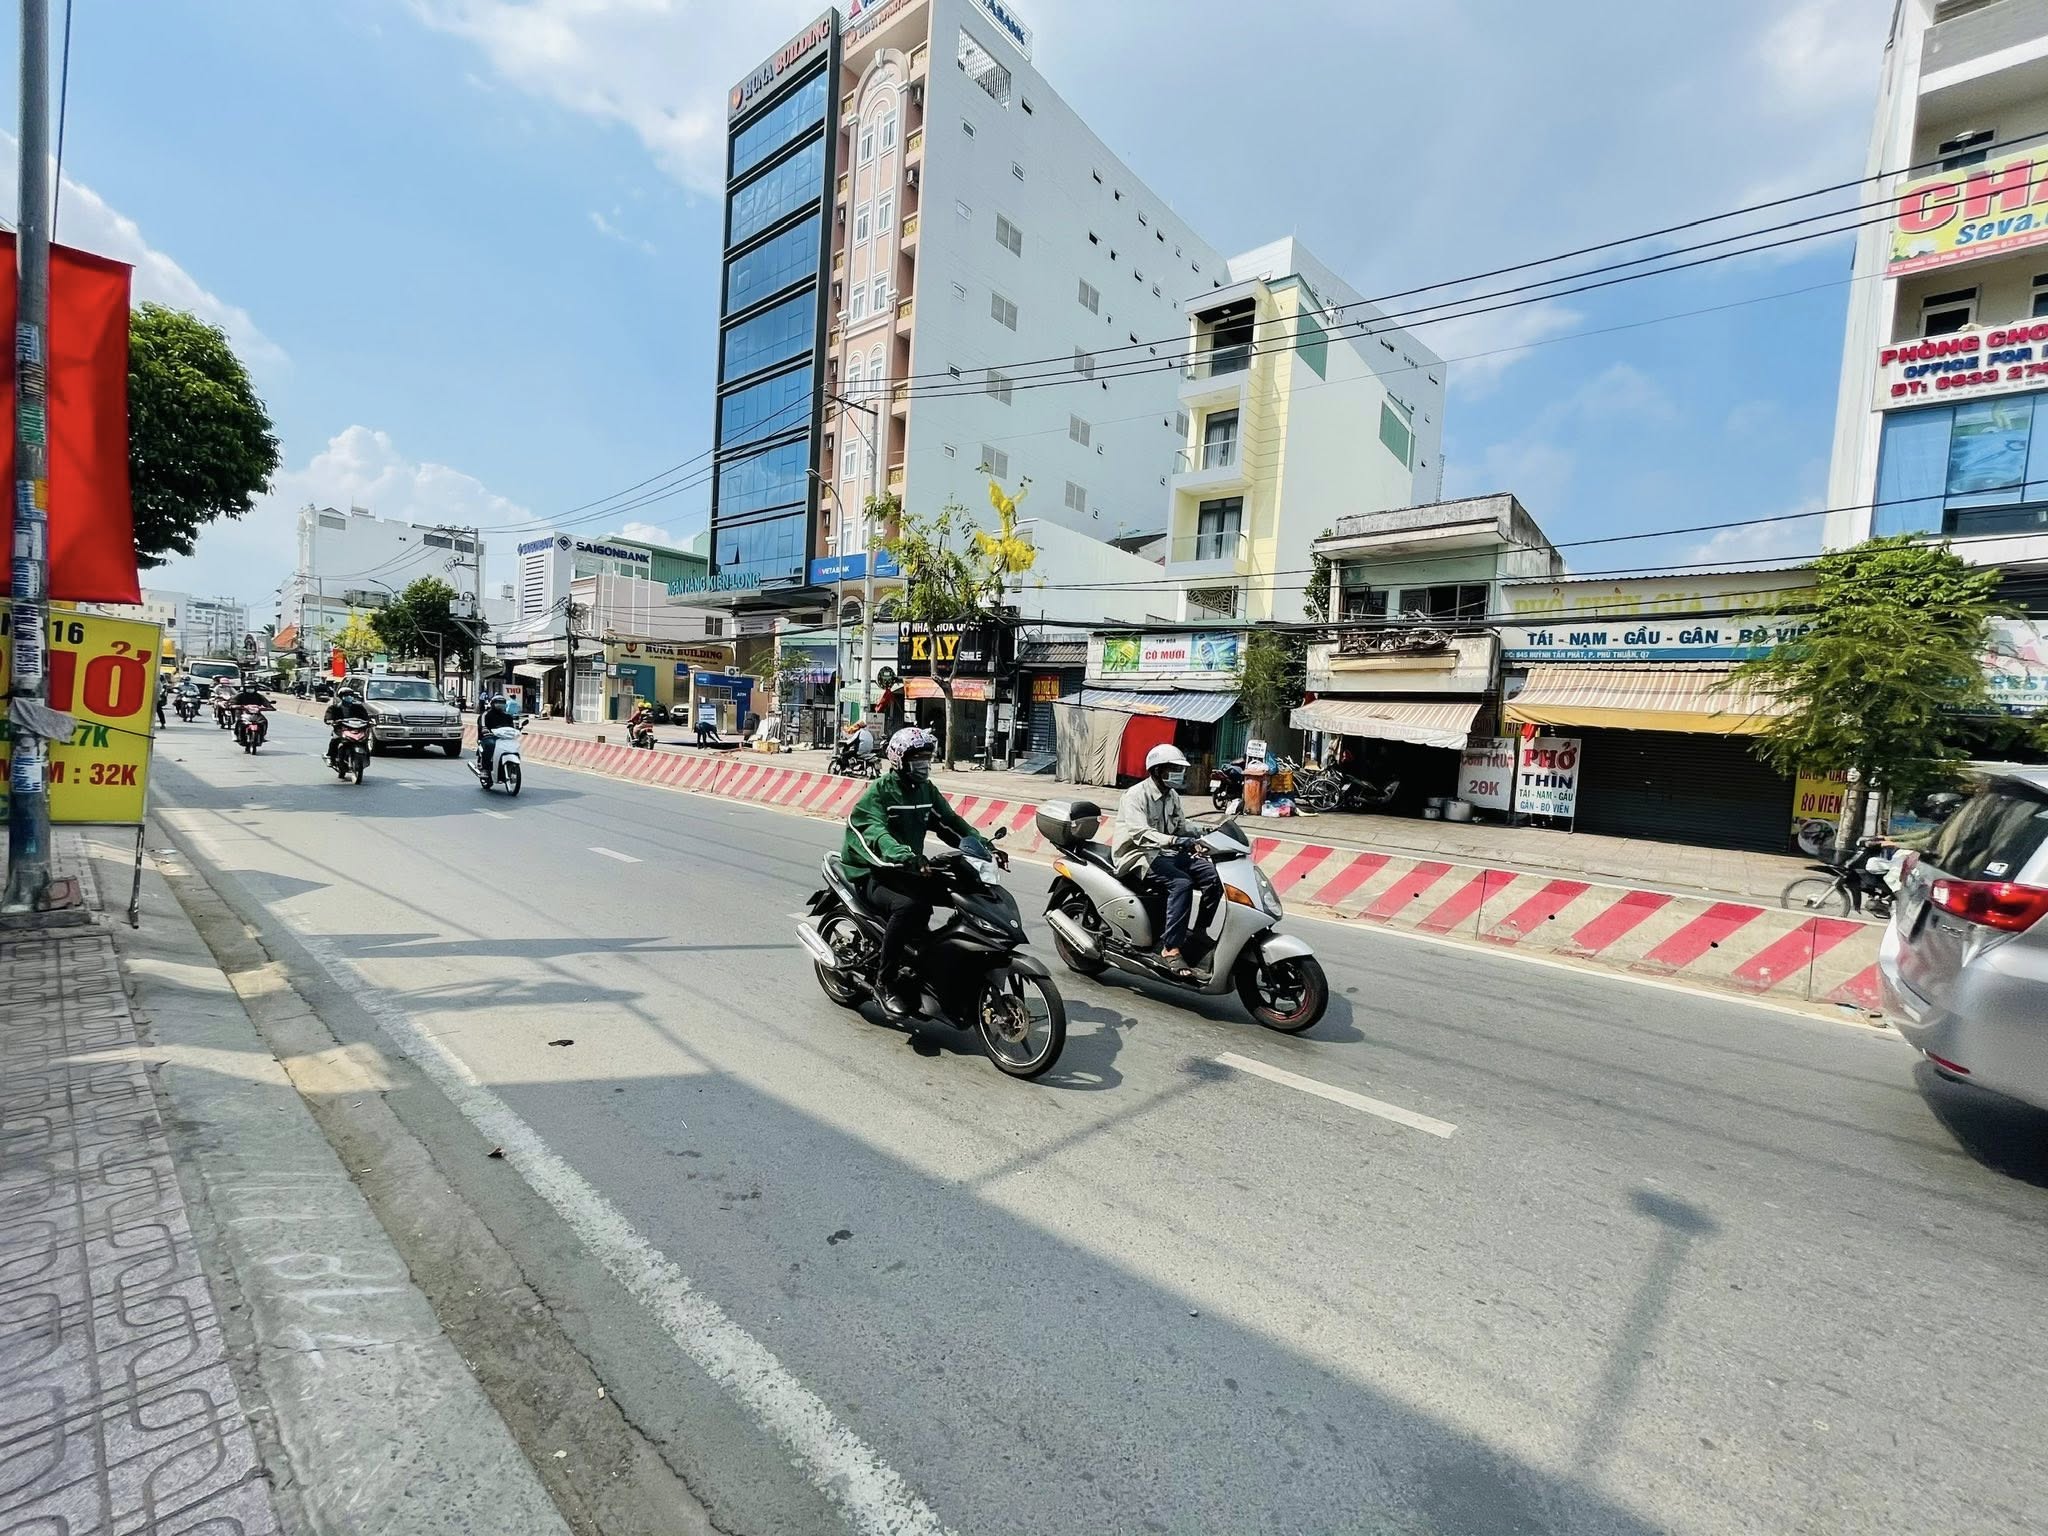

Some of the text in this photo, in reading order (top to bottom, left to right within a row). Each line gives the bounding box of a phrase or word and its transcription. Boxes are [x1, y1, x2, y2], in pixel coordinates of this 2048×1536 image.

[776, 18, 831, 76] BUILDING
[1955, 211, 2048, 246] Seva.
[1881, 335, 1980, 367] PHÒNG
[1904, 356, 1979, 379] OFFICE
[1987, 347, 2033, 366] FOR
[1936, 369, 1999, 391] 0933
[576, 541, 650, 564] SAIGONBANK
[732, 572, 761, 590] LONG
[52, 620, 85, 645] 16
[1527, 629, 1554, 646] TÁI
[1569, 632, 1607, 648] NẠM
[1624, 625, 1661, 645] GẦU
[1679, 627, 1719, 644] GÂN
[677, 648, 723, 660] BUILDING
[960, 651, 982, 661] SMILE
[1523, 741, 1578, 770] PHỞ
[89, 763, 138, 787] 32K
[1521, 770, 1574, 790] THÌN
[1468, 780, 1500, 796] 20K
